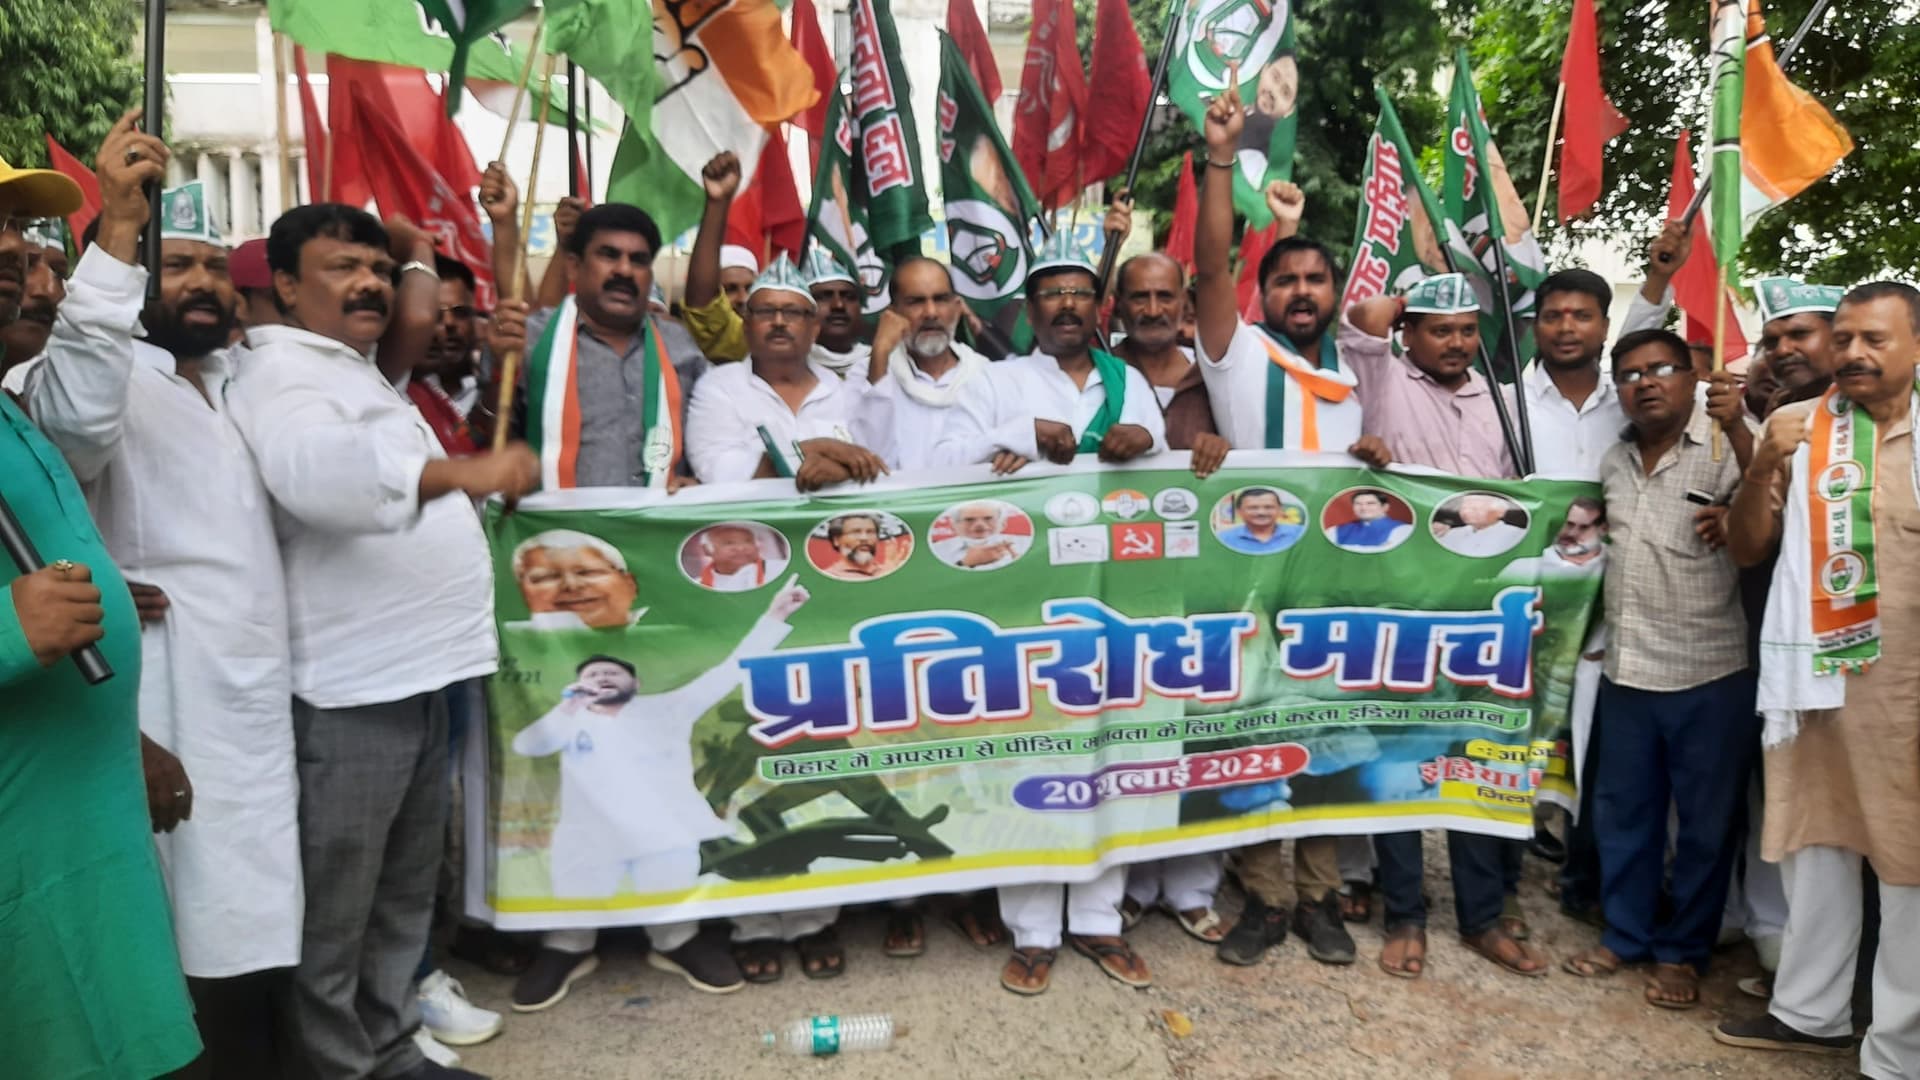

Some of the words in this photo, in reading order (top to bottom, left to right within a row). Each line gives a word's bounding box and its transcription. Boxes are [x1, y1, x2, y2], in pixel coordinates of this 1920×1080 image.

[863, 112, 914, 197] दल
[738, 598, 1256, 748] प्रतिरोध
[1276, 586, 1544, 698] मार्च
[774, 759, 838, 776] बिहार
[850, 751, 870, 768] में
[880, 746, 964, 766] अपराध
[975, 740, 995, 757] से
[1157, 722, 1178, 738] के
[1185, 720, 1224, 736] लिए
[1284, 708, 1340, 724] करता
[1040, 779, 1092, 806] 20
[1200, 750, 1283, 782] 2024
